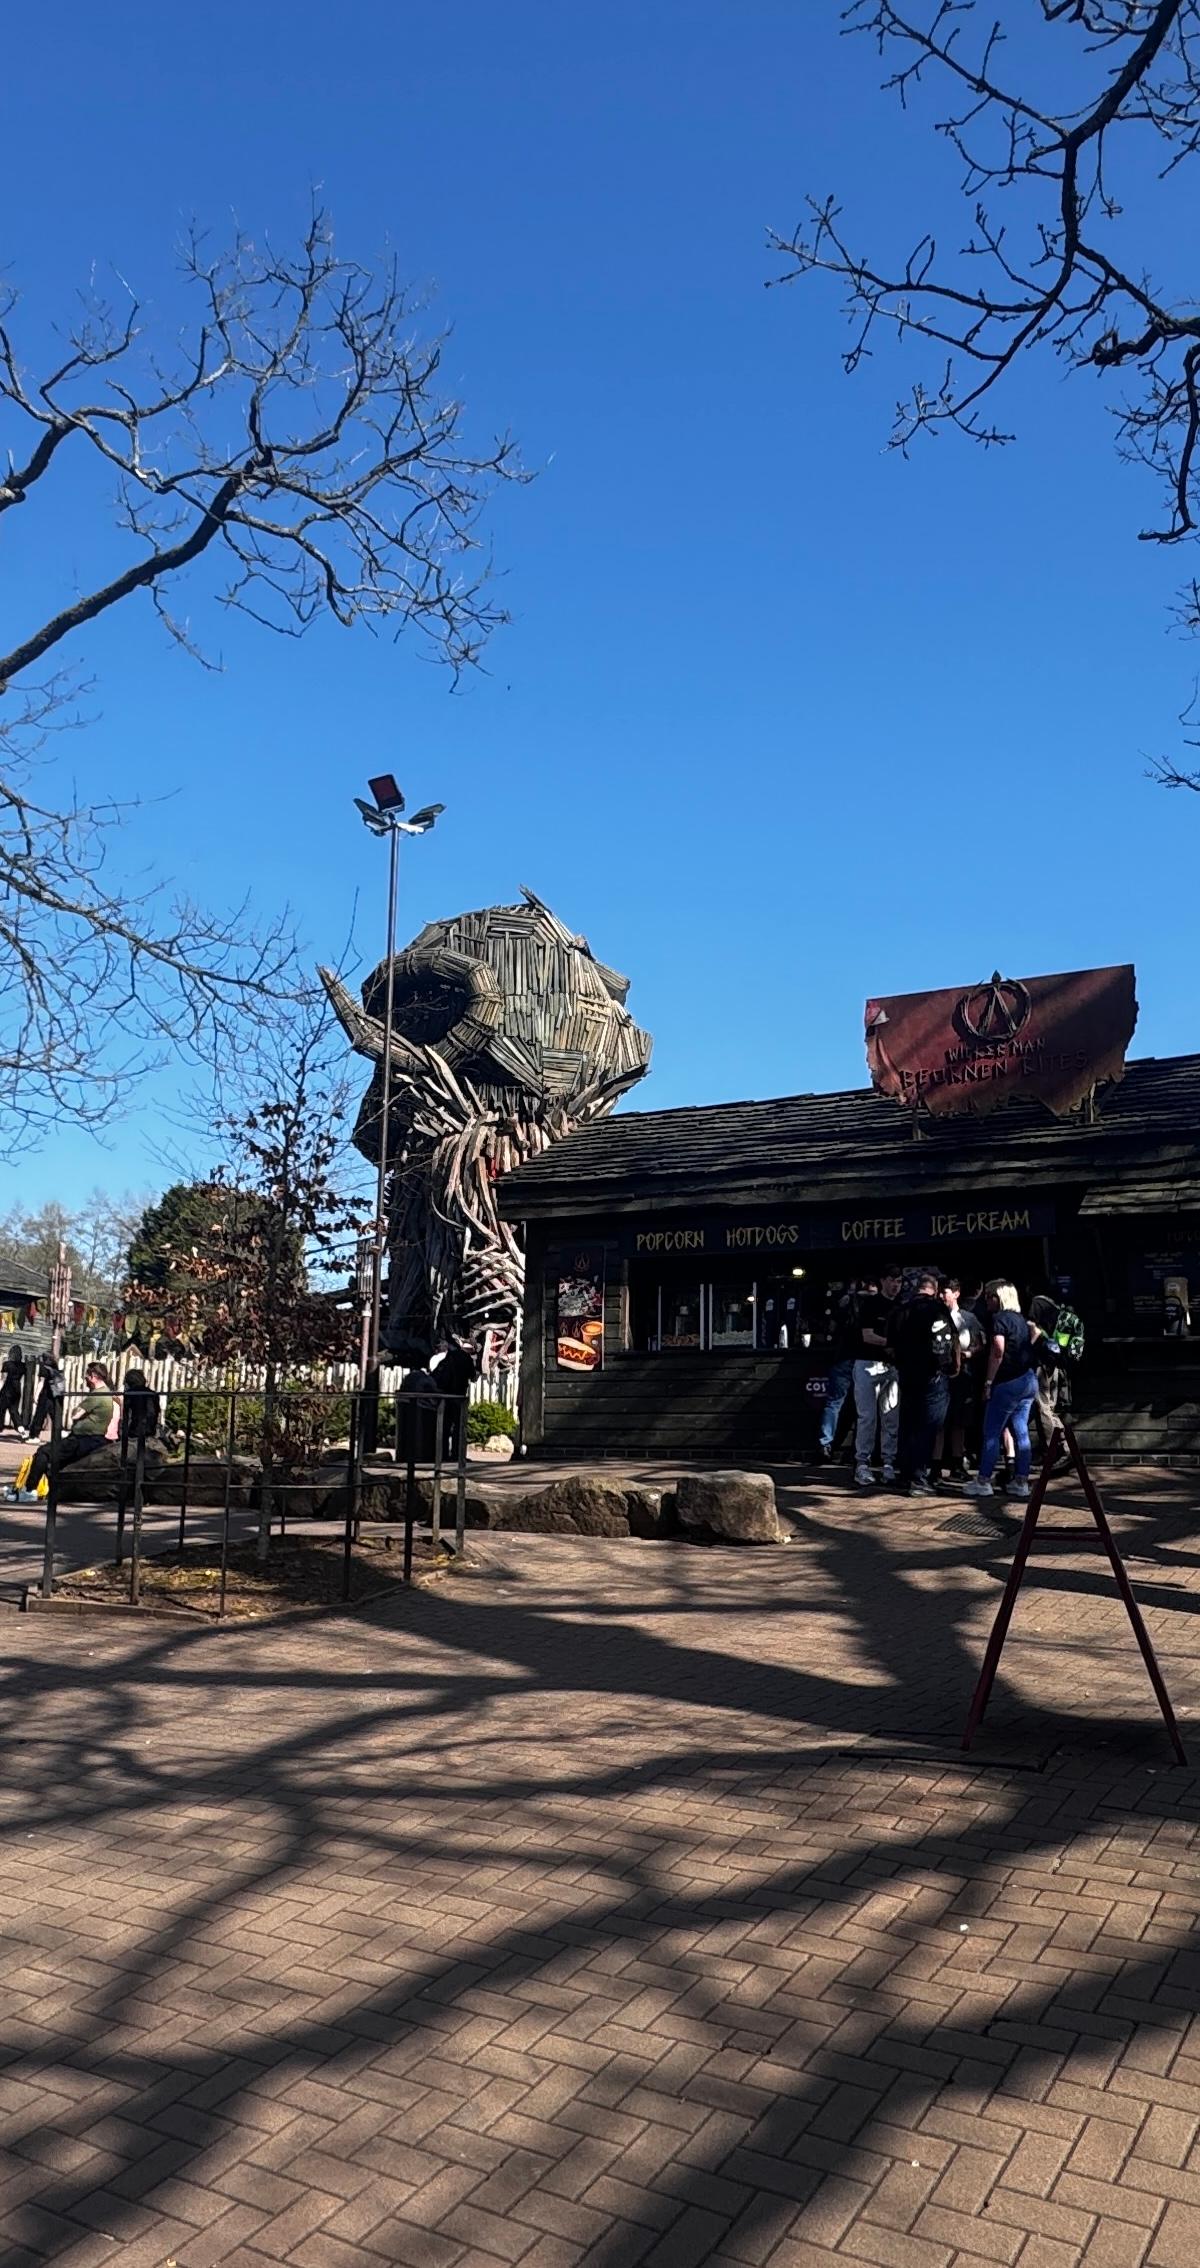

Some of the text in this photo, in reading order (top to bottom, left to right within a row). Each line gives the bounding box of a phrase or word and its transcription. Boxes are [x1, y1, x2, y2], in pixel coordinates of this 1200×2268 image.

[636, 1208, 1031, 1251] POPCORN HOTDOGS COFFEE ICE-CREAM
[805, 1381, 827, 1393] COS
